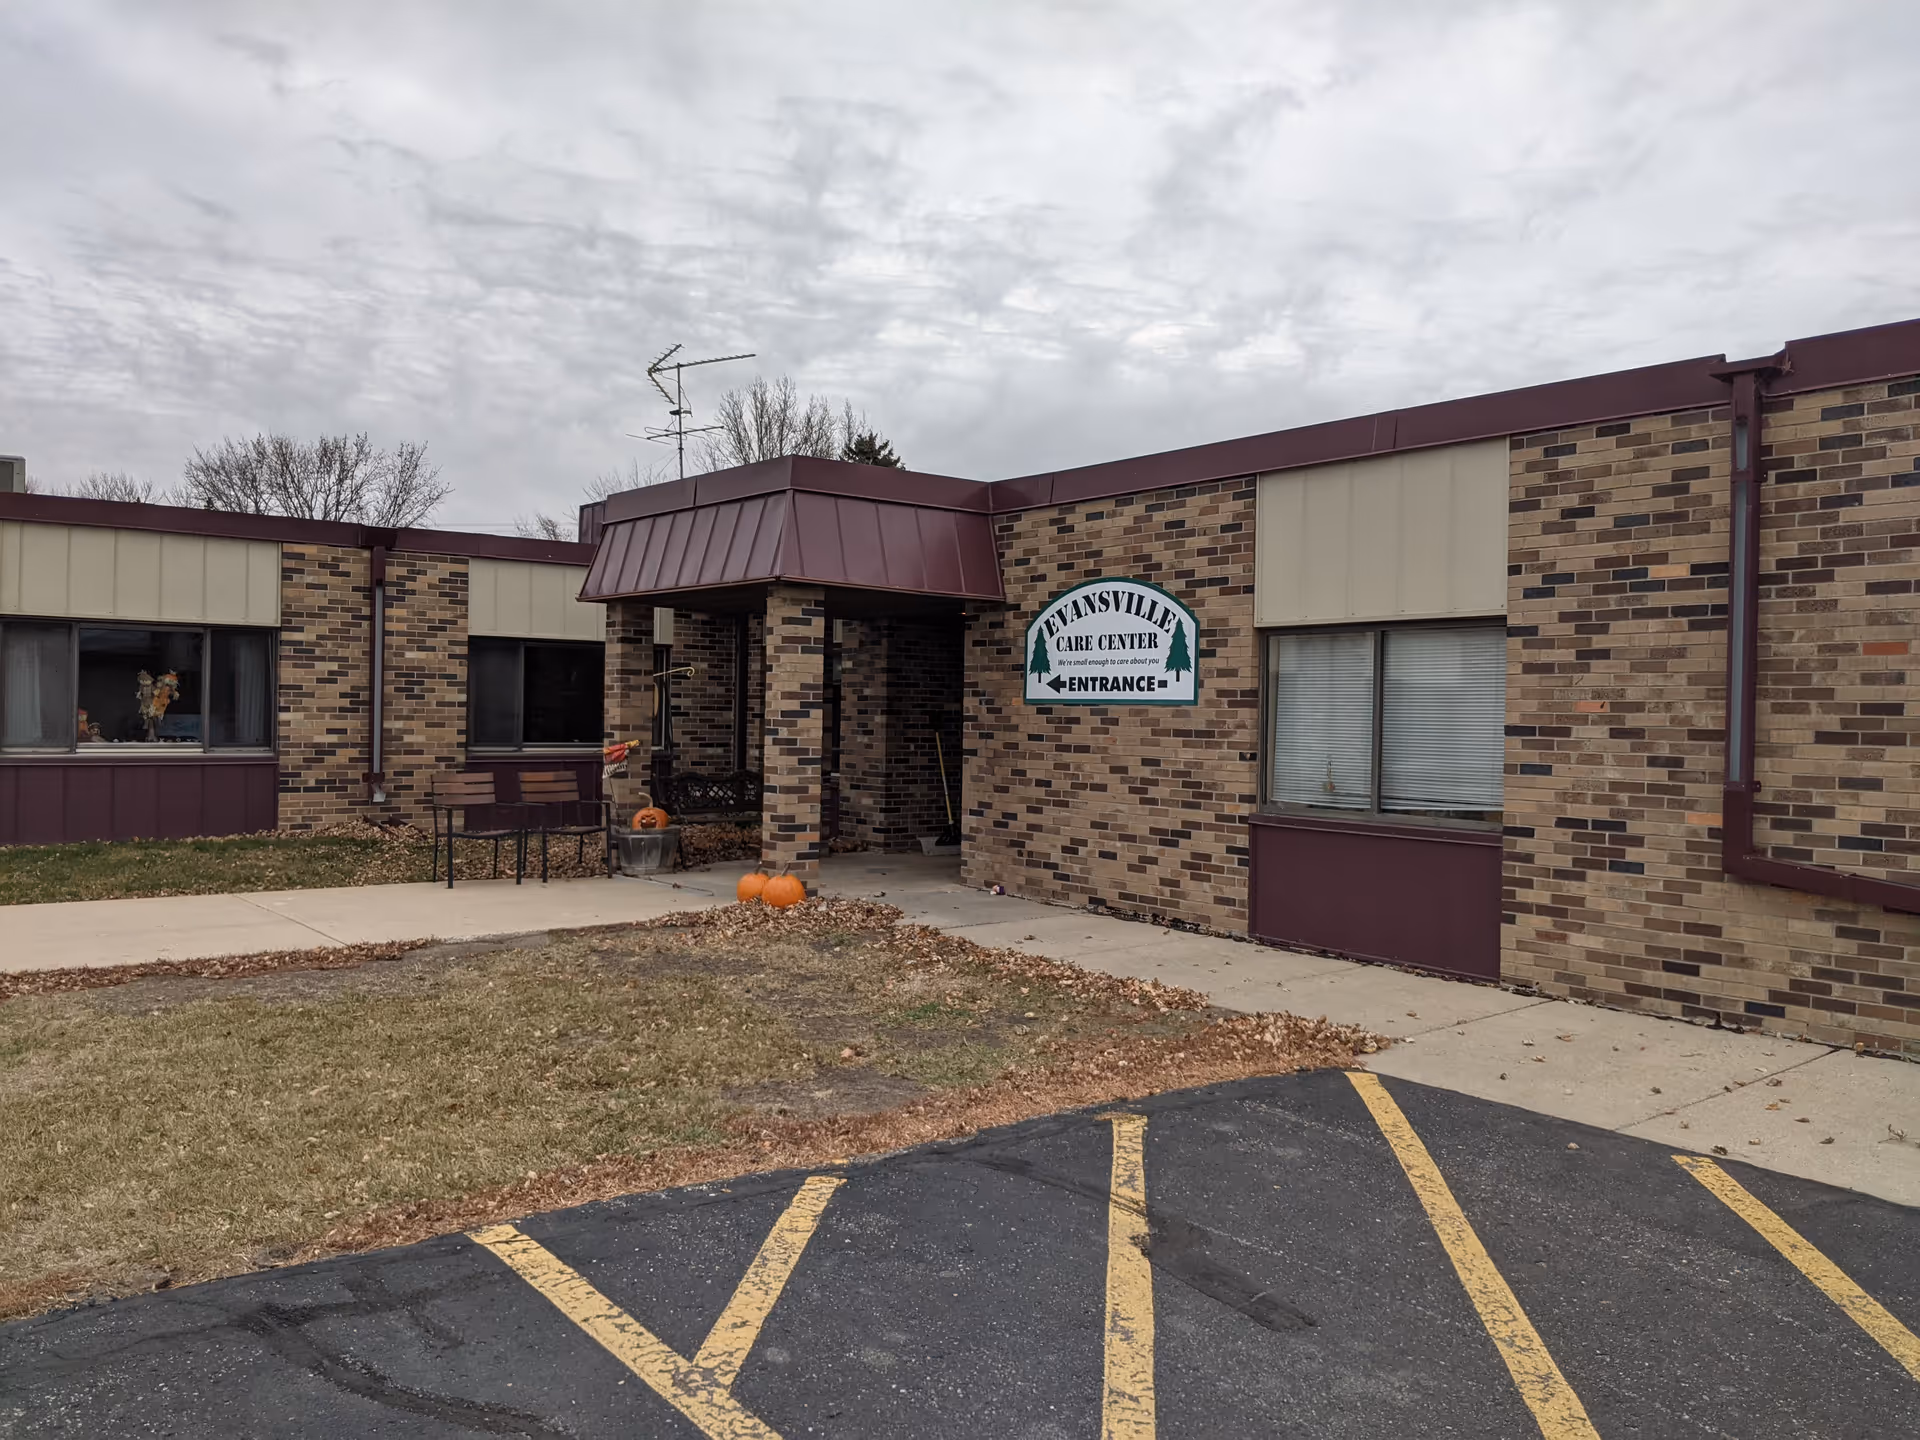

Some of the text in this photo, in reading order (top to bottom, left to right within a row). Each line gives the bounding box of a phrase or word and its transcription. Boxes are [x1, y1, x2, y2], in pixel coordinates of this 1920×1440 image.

[1044, 590, 1177, 639] EVANSVILLE
[1056, 632, 1159, 652] CARE CENTER
[1057, 659, 1072, 667] We're
[1073, 658, 1088, 666] small
[1088, 658, 1109, 668] enough
[1130, 657, 1148, 665] about
[1148, 658, 1160, 666] you
[1068, 676, 1156, 692] ENTRANCE
